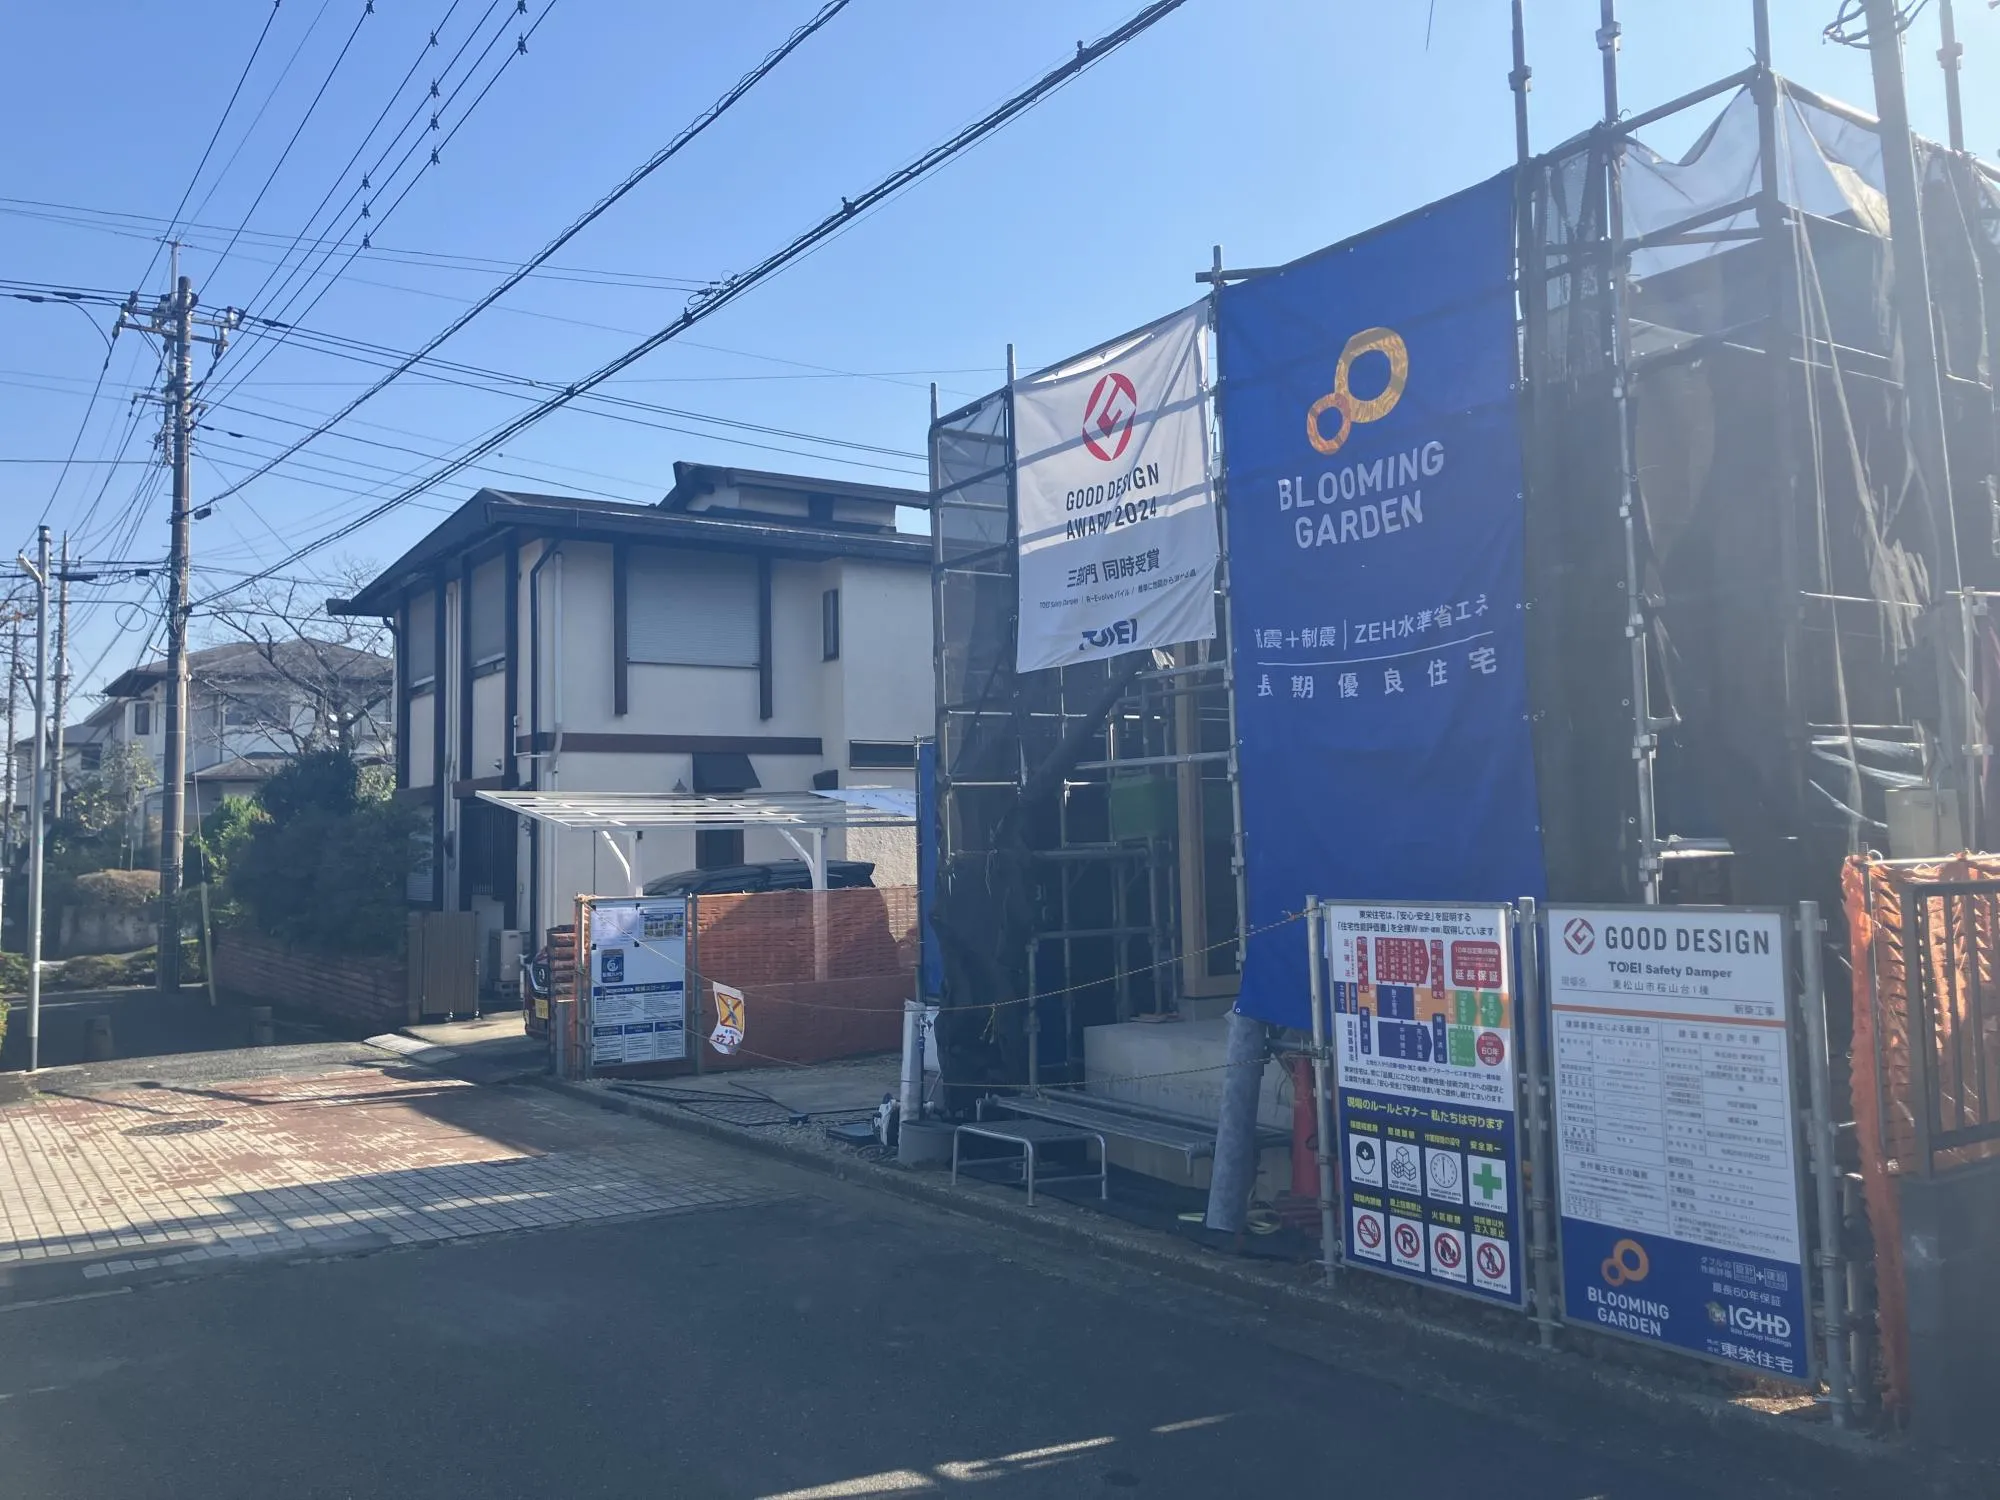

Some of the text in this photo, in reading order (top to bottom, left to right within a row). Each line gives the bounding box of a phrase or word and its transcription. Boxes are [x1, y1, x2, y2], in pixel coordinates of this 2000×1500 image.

[1066, 462, 1159, 511] GOOD DESIGN
[1277, 440, 1445, 512] BLOOMING
[1114, 495, 1157, 527] 2024
[1294, 490, 1424, 549] GARDEN
[1066, 548, 1161, 589] 三部門 同時受賞
[1257, 645, 1498, 700] 長期優良住宅
[1605, 926, 1770, 955] GOOD DESIGN
[1455, 969, 1499, 982] 延長保証
[1645, 964, 1682, 978] Safety
[1685, 966, 1733, 980] Damper
[1347, 1096, 1505, 1131] 現場のルールとマナー 私たちは守ります
[1469, 1140, 1503, 1153] 安全第一
[1587, 1286, 1670, 1321] BLOOMING
[1597, 1307, 1663, 1338] GARDEN
[1720, 1342, 1794, 1374] 東栄住宅
